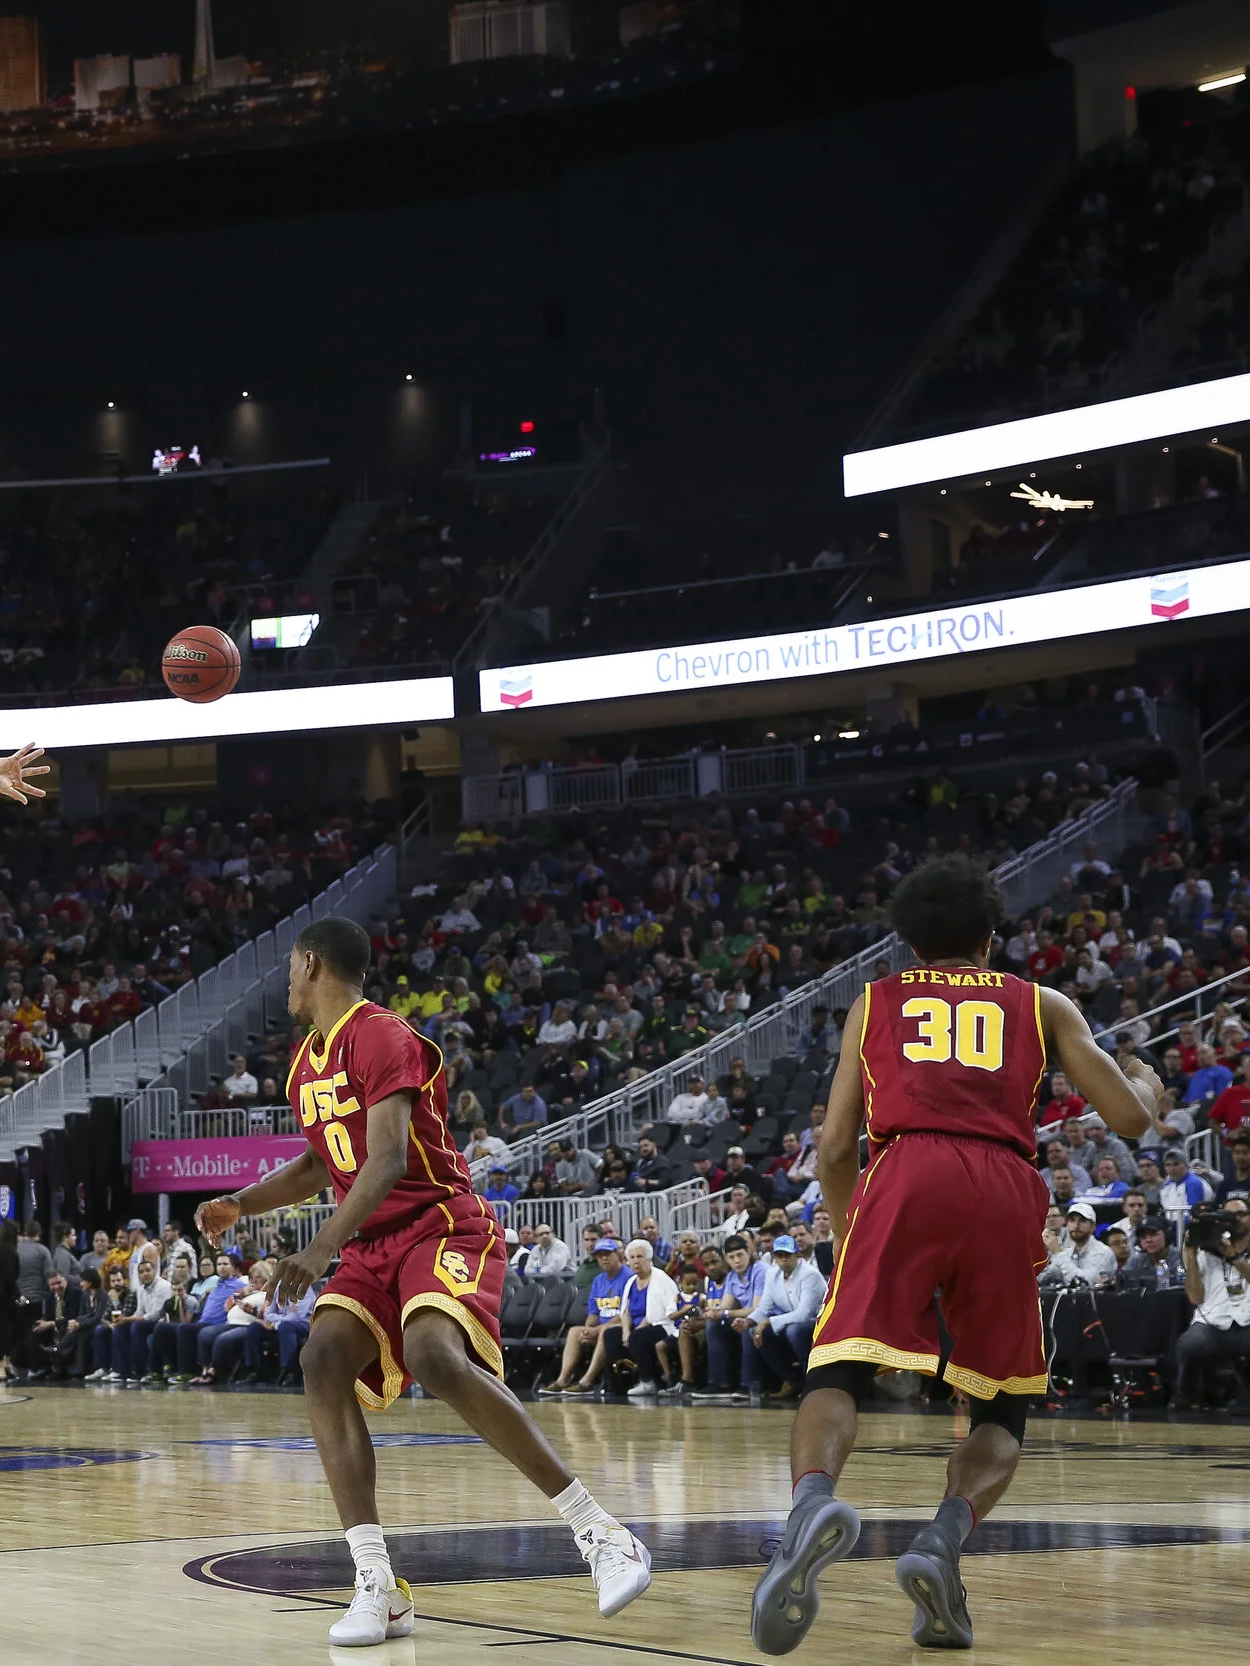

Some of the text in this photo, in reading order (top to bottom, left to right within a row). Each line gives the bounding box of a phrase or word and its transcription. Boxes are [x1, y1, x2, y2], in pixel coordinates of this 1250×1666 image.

[168, 672, 199, 684] NCAA
[655, 645, 770, 683] Chevron
[779, 635, 839, 668] with
[901, 969, 1006, 988] STEWART
[902, 997, 1005, 1072] 30
[299, 1070, 361, 1127] USC
[323, 1121, 357, 1173] 0
